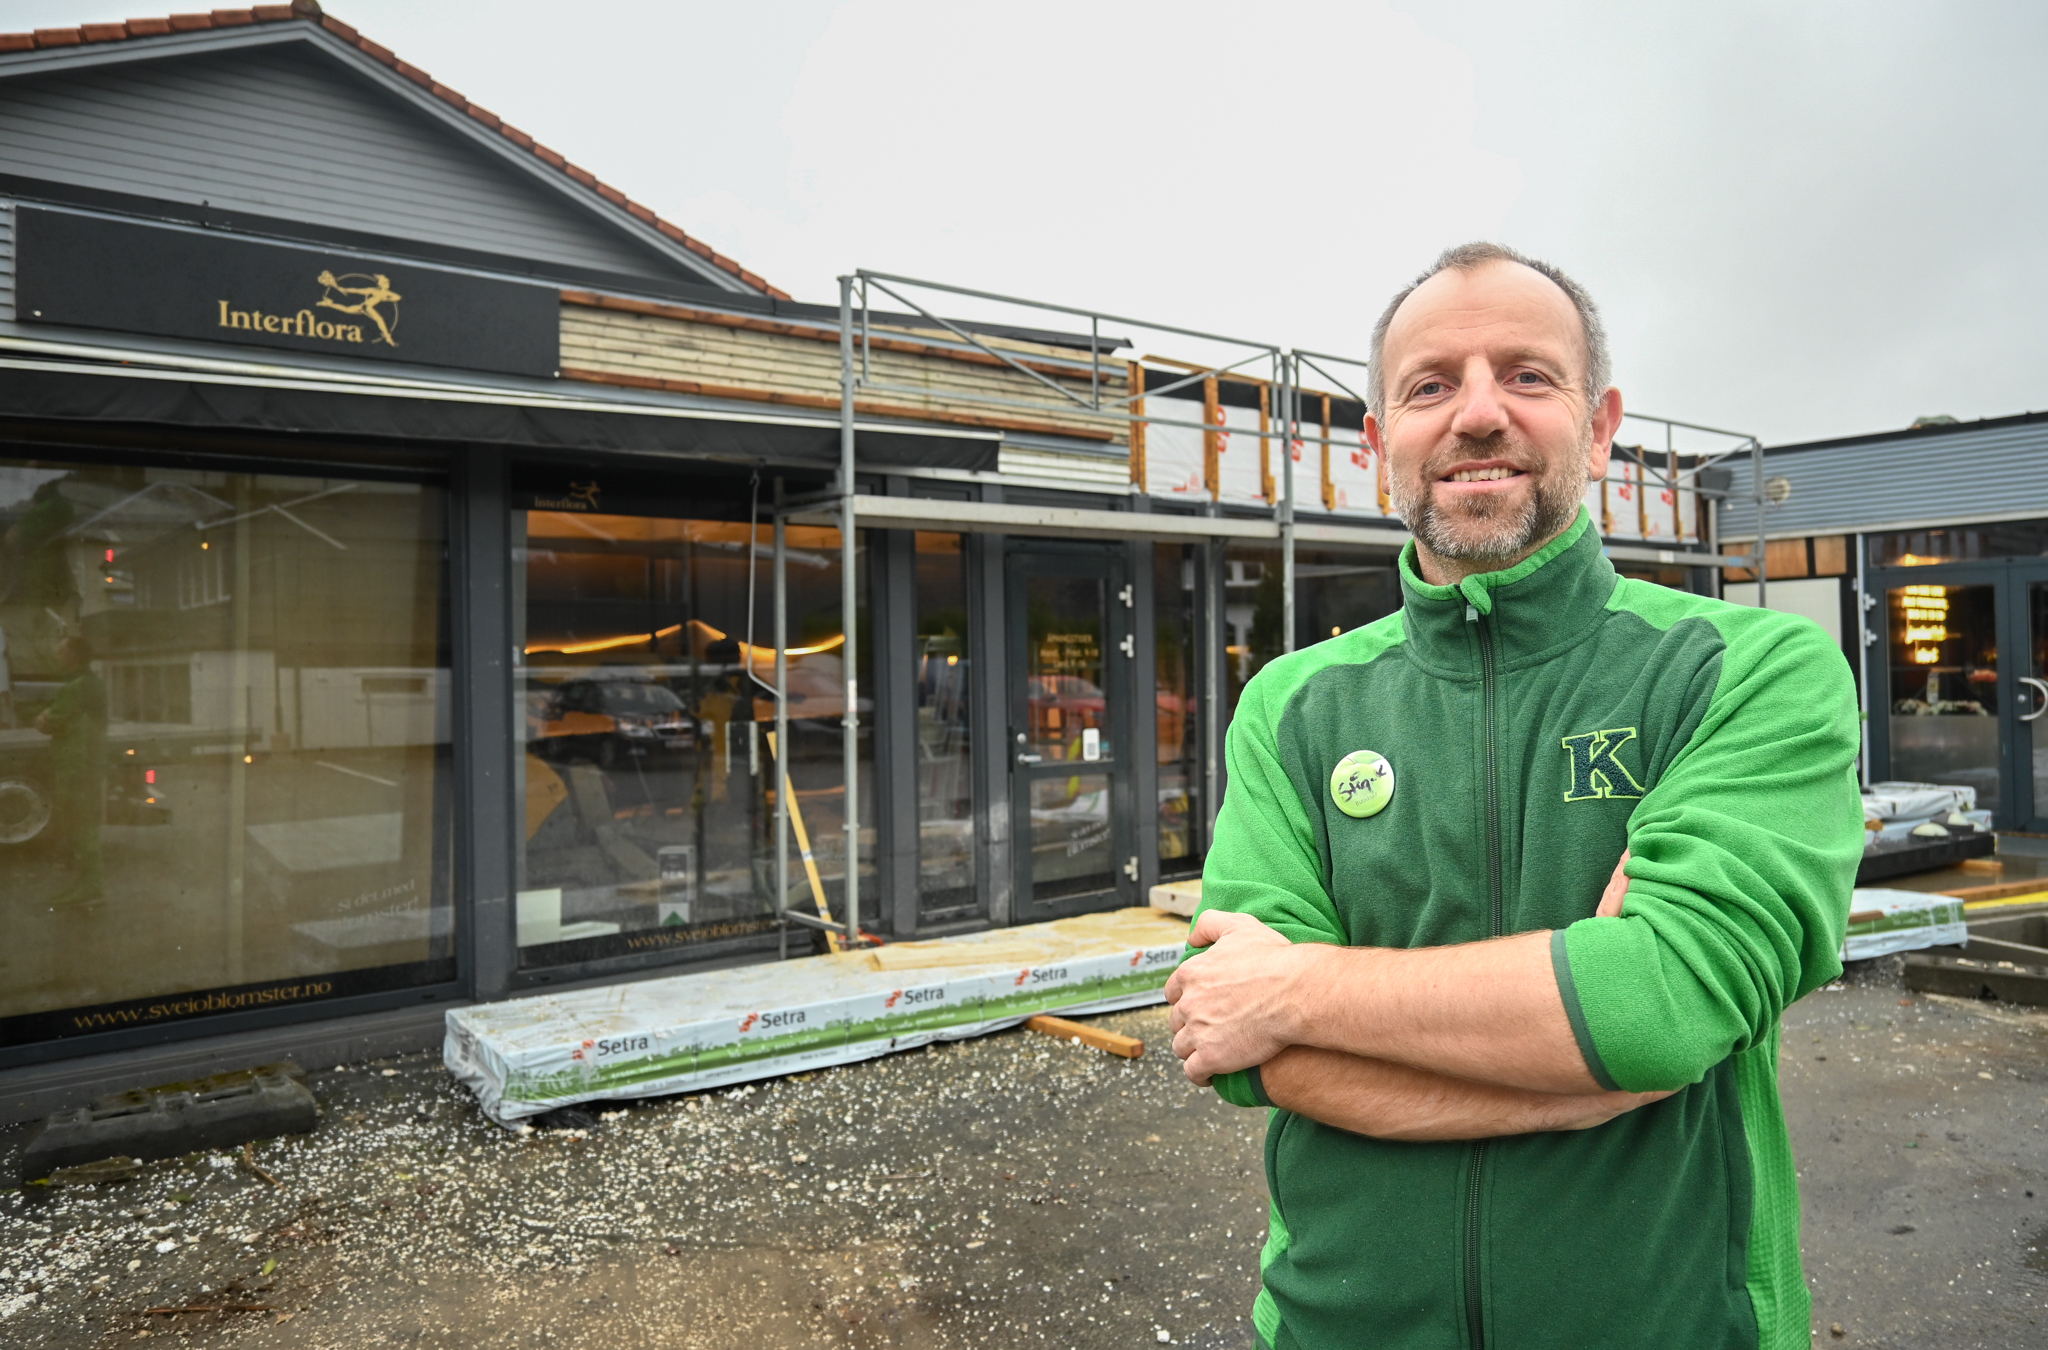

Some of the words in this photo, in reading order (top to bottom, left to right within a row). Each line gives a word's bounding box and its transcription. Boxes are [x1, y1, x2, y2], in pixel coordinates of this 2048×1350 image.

[218, 300, 363, 342] Interflora
[535, 496, 586, 510] Interflora
[1562, 726, 1645, 802] K
[1146, 949, 1177, 965] Setra
[1032, 967, 1068, 983] Setra
[73, 981, 333, 1029] www.sveioblomster.no
[904, 987, 945, 1005] Setra
[761, 1010, 806, 1029] Setra
[597, 1036, 649, 1057] Setra
